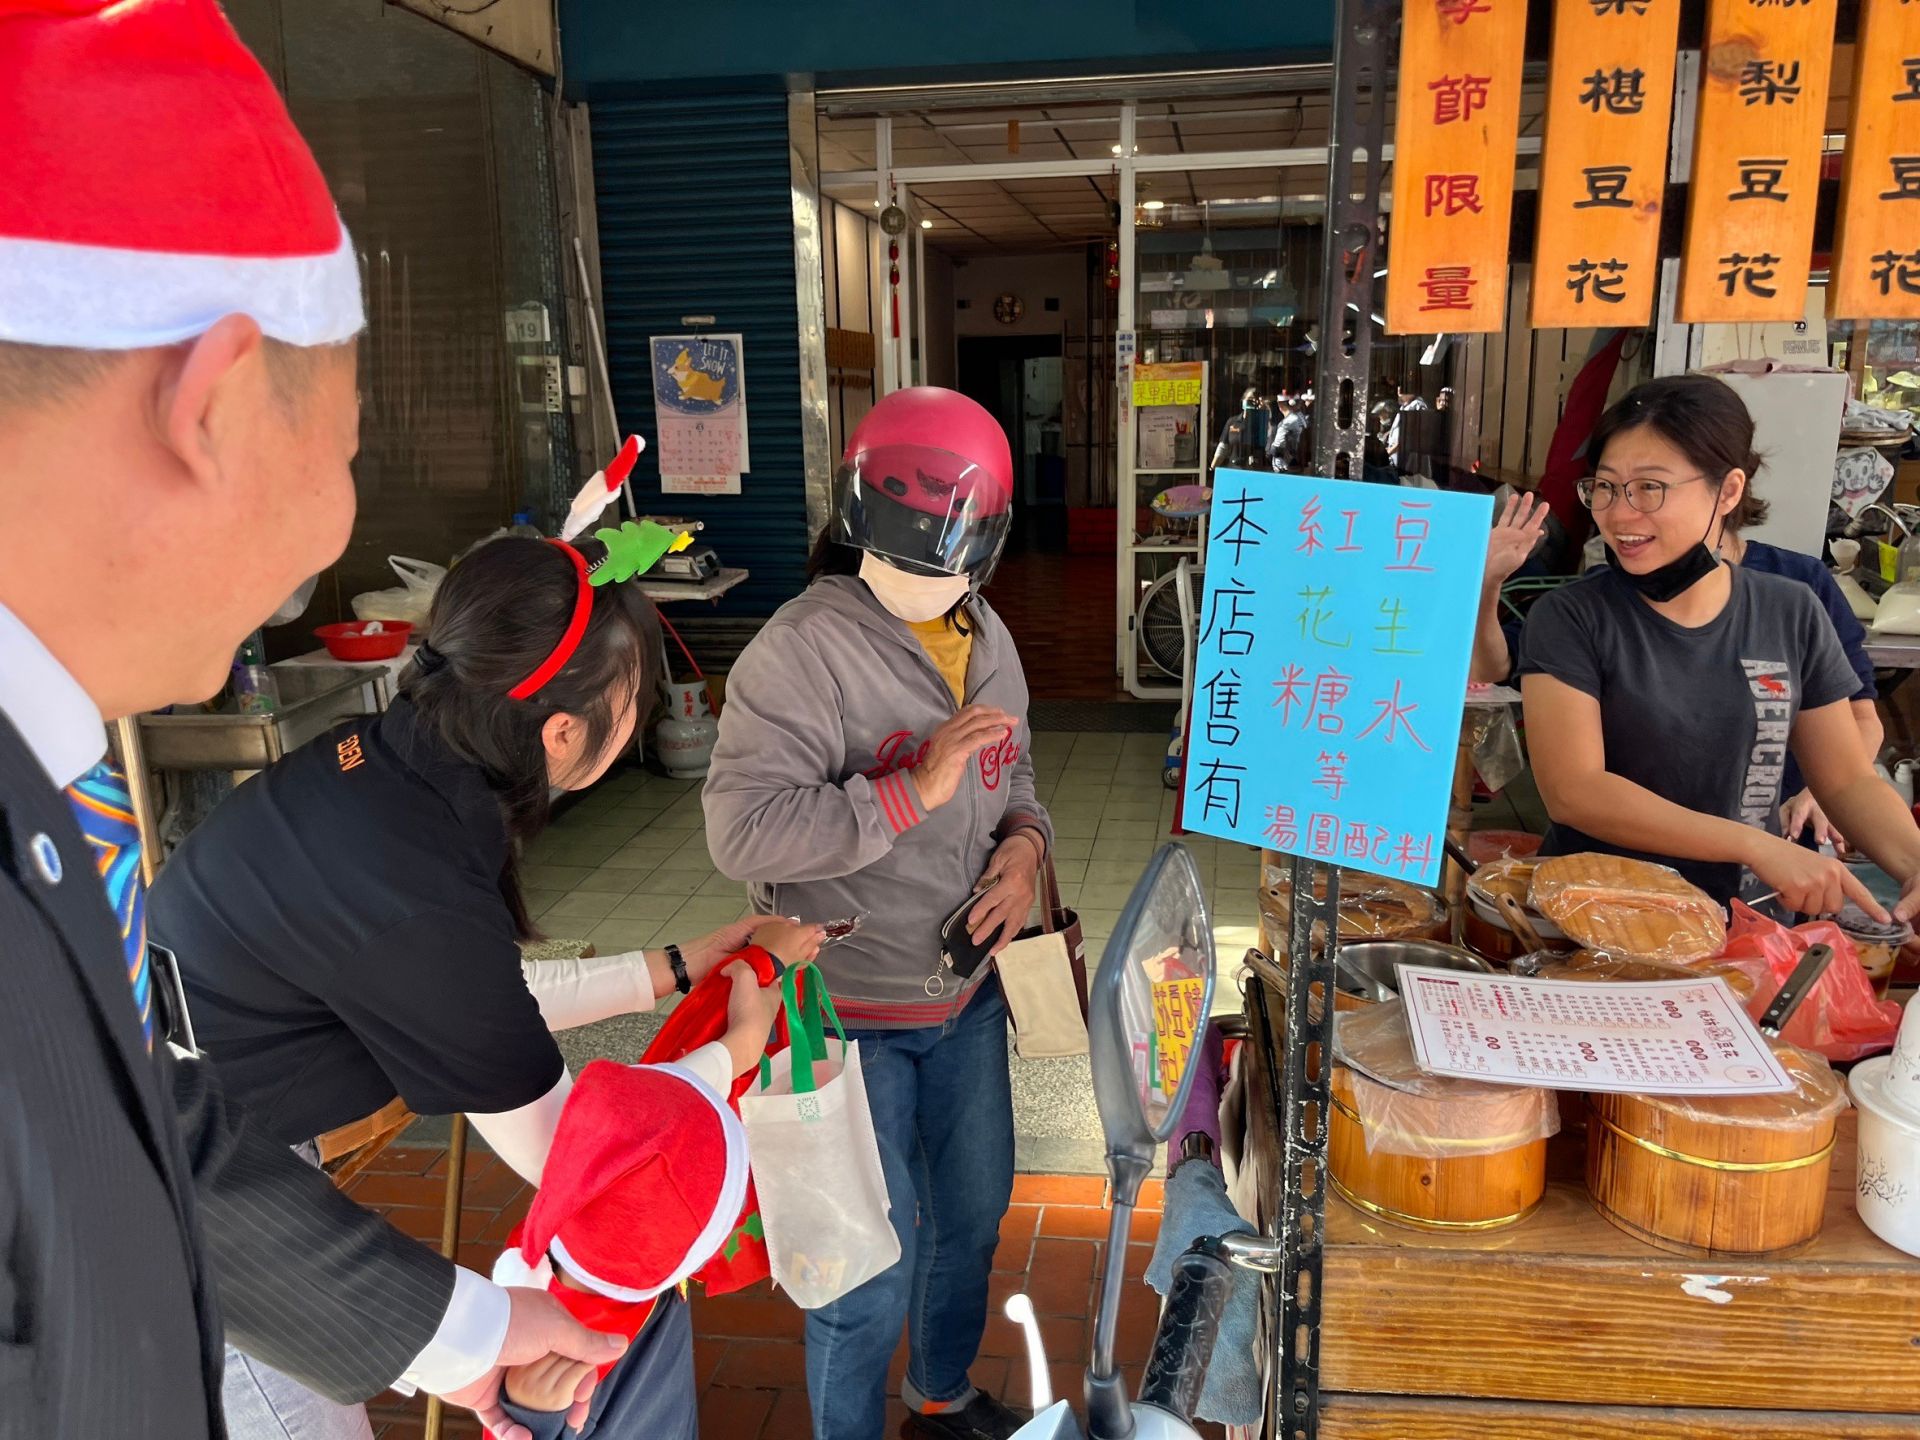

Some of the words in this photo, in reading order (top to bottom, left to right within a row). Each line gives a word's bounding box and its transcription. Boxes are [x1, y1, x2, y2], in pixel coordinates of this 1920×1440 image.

[1718, 0, 1809, 299] 梨豆花
[700, 356, 727, 376] SNOW
[703, 343, 717, 357] LET
[719, 348, 729, 361] IT
[1295, 494, 1435, 573] 紅豆
[1295, 584, 1425, 656] 花生
[1194, 487, 1269, 829] 本店售有
[1271, 662, 1432, 752] 糖水
[337, 733, 366, 772] EDEN
[1311, 751, 1350, 801] 等
[1262, 803, 1438, 878] 湯圓配料
